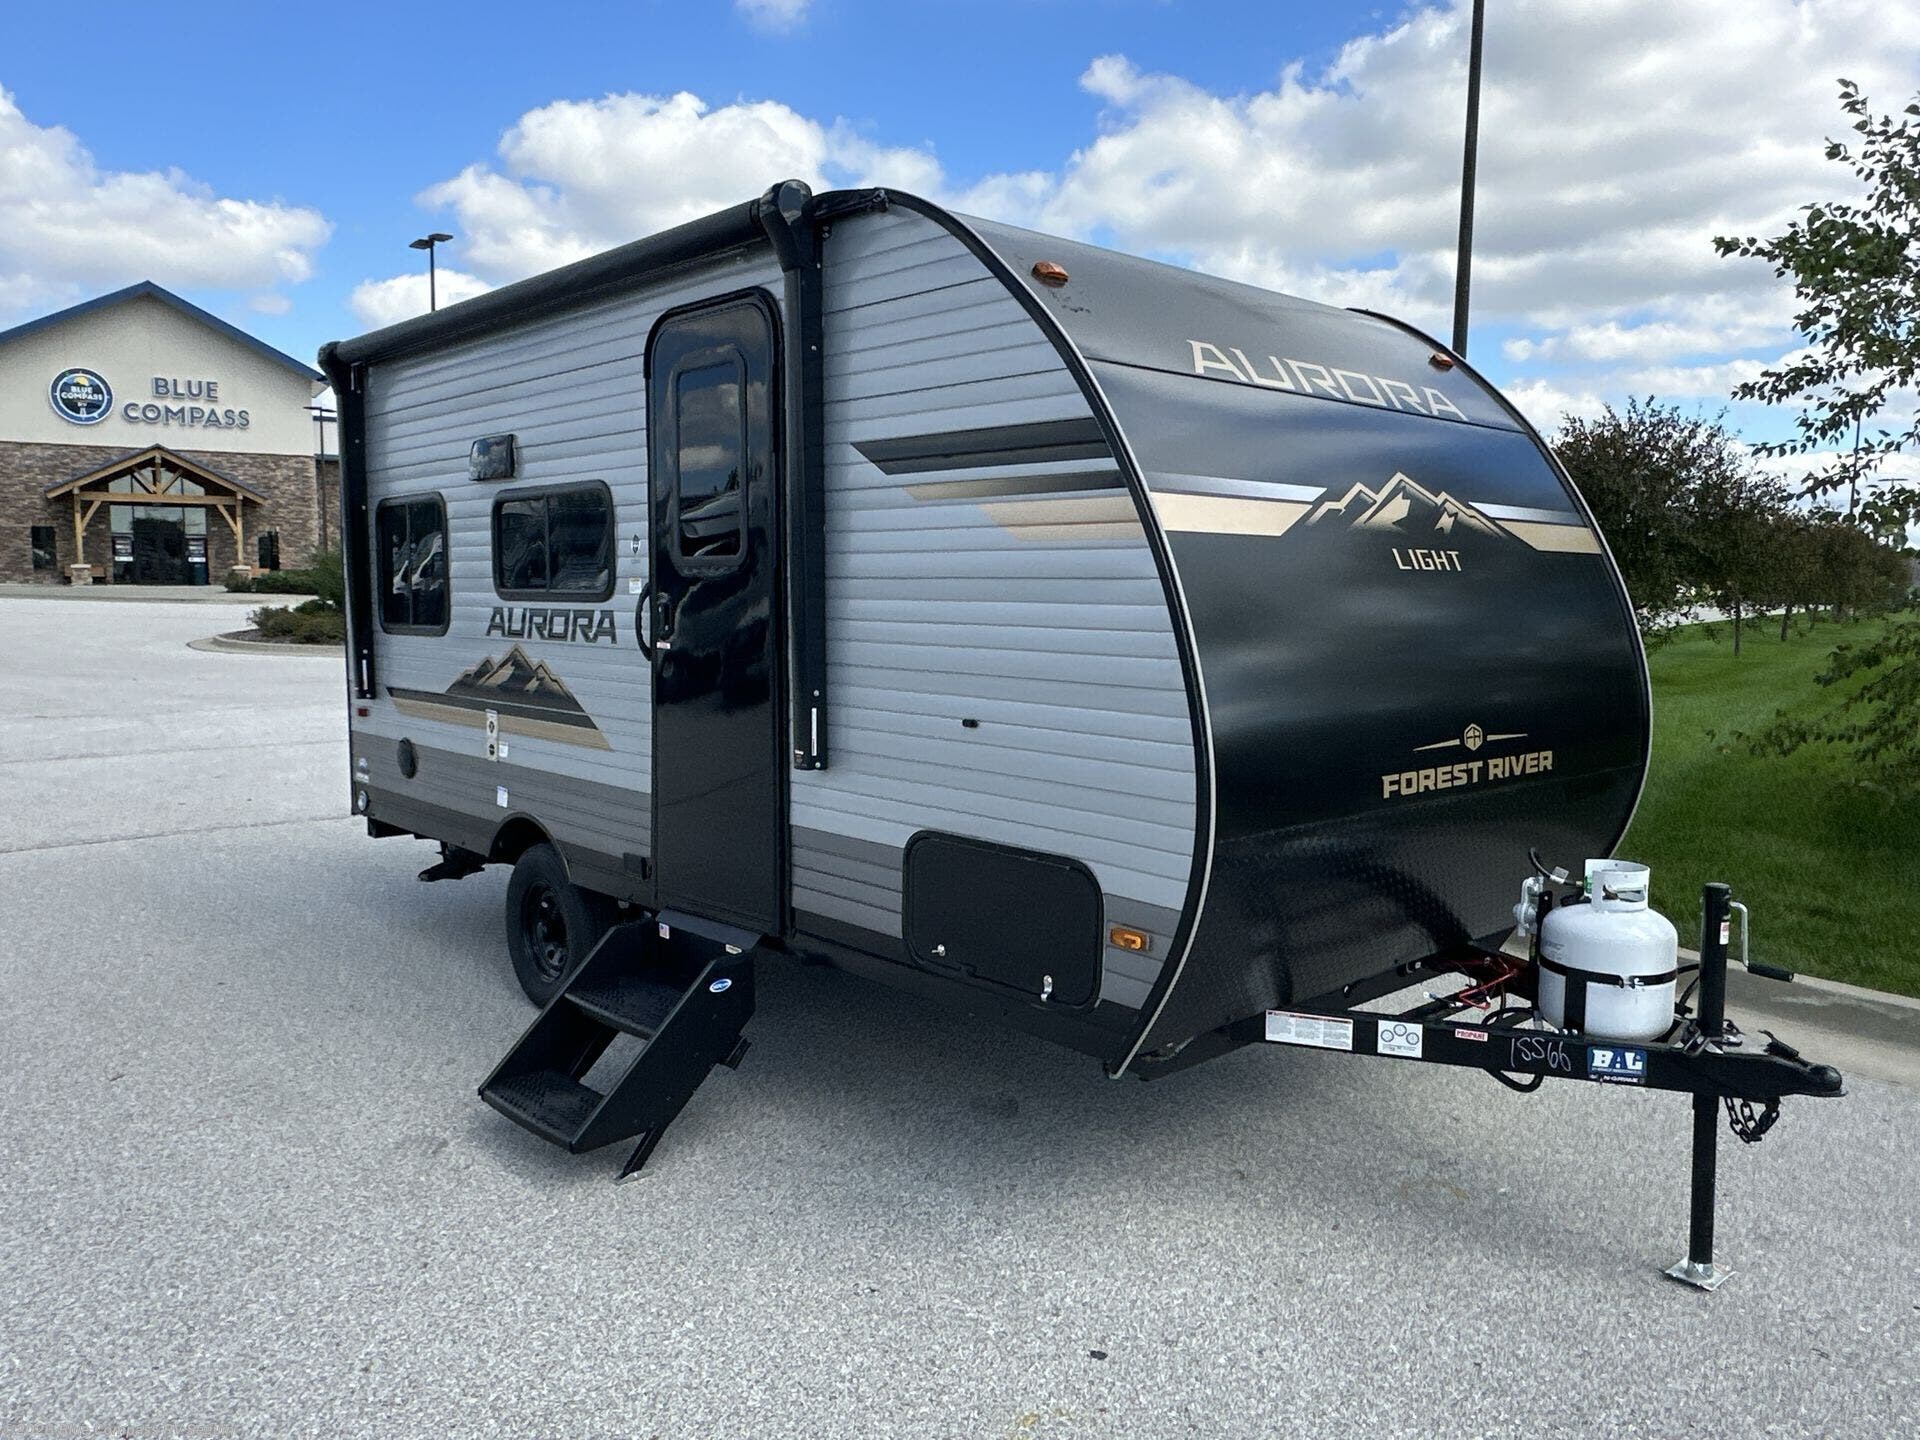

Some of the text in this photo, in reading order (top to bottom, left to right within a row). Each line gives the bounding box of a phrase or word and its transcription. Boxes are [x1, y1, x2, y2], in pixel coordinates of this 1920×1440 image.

[70, 385, 93, 394] BLUE
[152, 376, 219, 400] BLUE
[1187, 339, 1469, 421] AURORA
[61, 391, 103, 401] COMPASS
[122, 402, 250, 428] COMPASS
[1391, 547, 1462, 572] LIGHT
[485, 606, 618, 645] AURORA
[1381, 750, 1553, 800] FOREST RIVER
